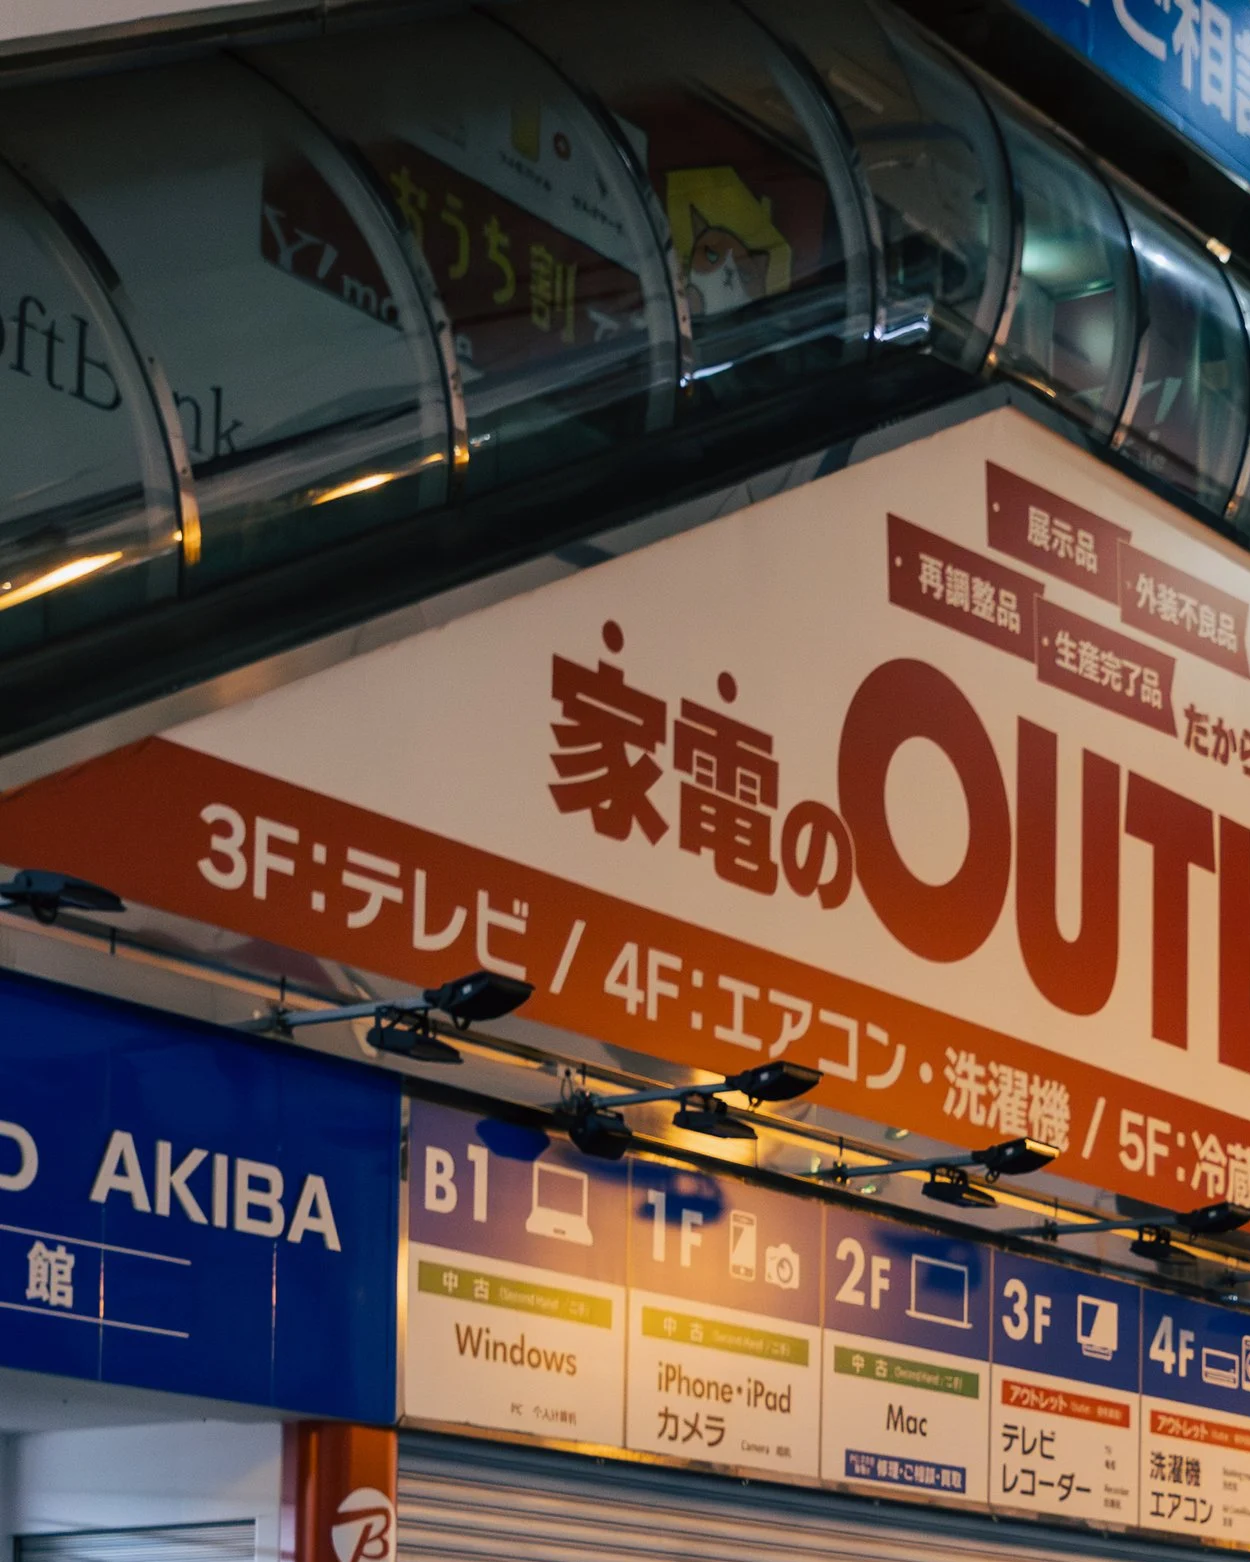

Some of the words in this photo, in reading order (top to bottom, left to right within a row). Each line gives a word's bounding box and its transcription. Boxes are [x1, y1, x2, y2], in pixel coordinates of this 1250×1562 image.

[1025, 505, 1099, 574] 展示品
[918, 554, 1022, 634] 再調整品
[1134, 574, 1239, 654] 外装不良品
[1055, 631, 1163, 709] 生産完了品
[547, 621, 855, 911] 家電の
[89, 1129, 342, 1253] AKIBA
[424, 1143, 489, 1223] B1
[647, 1188, 704, 1268] 1F
[25, 1240, 75, 1309] 館
[834, 1237, 892, 1311] 2F
[1002, 1278, 1052, 1345] 3F
[1149, 1314, 1195, 1378] 4F
[455, 1322, 578, 1377] Windows
[657, 1407, 726, 1449] カメラ
[886, 1403, 928, 1438] Mac
[1002, 1422, 1056, 1461] テレビ
[1002, 1463, 1093, 1502] レコーダー
[1149, 1451, 1201, 1488] 洗濯機
[1149, 1490, 1213, 1526] エアコン
